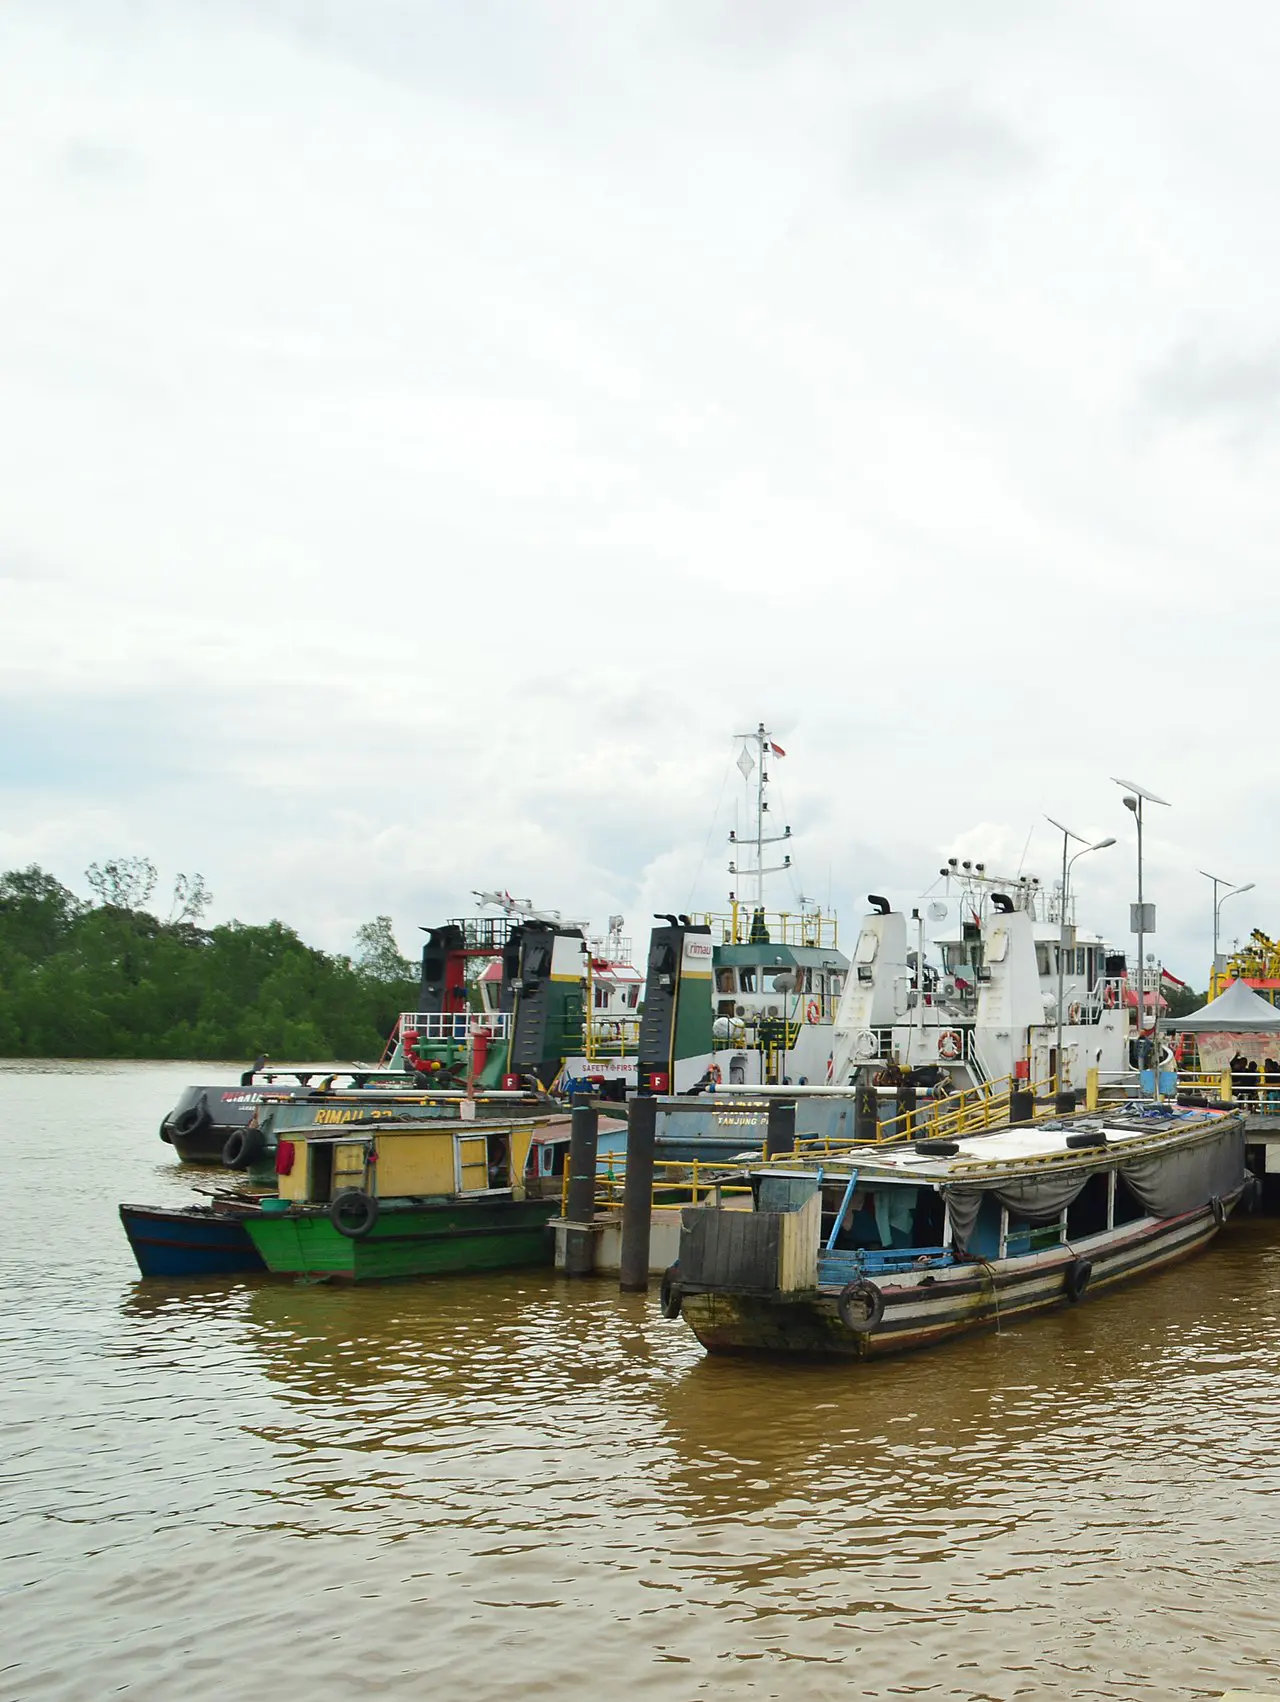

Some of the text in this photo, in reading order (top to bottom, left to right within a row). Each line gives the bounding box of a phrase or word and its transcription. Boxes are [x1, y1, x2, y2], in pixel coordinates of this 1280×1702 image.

[690, 942, 711, 955] rimau
[582, 1064, 638, 1072] SAFETY FIRST
[315, 1109, 364, 1124] RIMAU
[718, 1117, 757, 1126] TANJUNG
